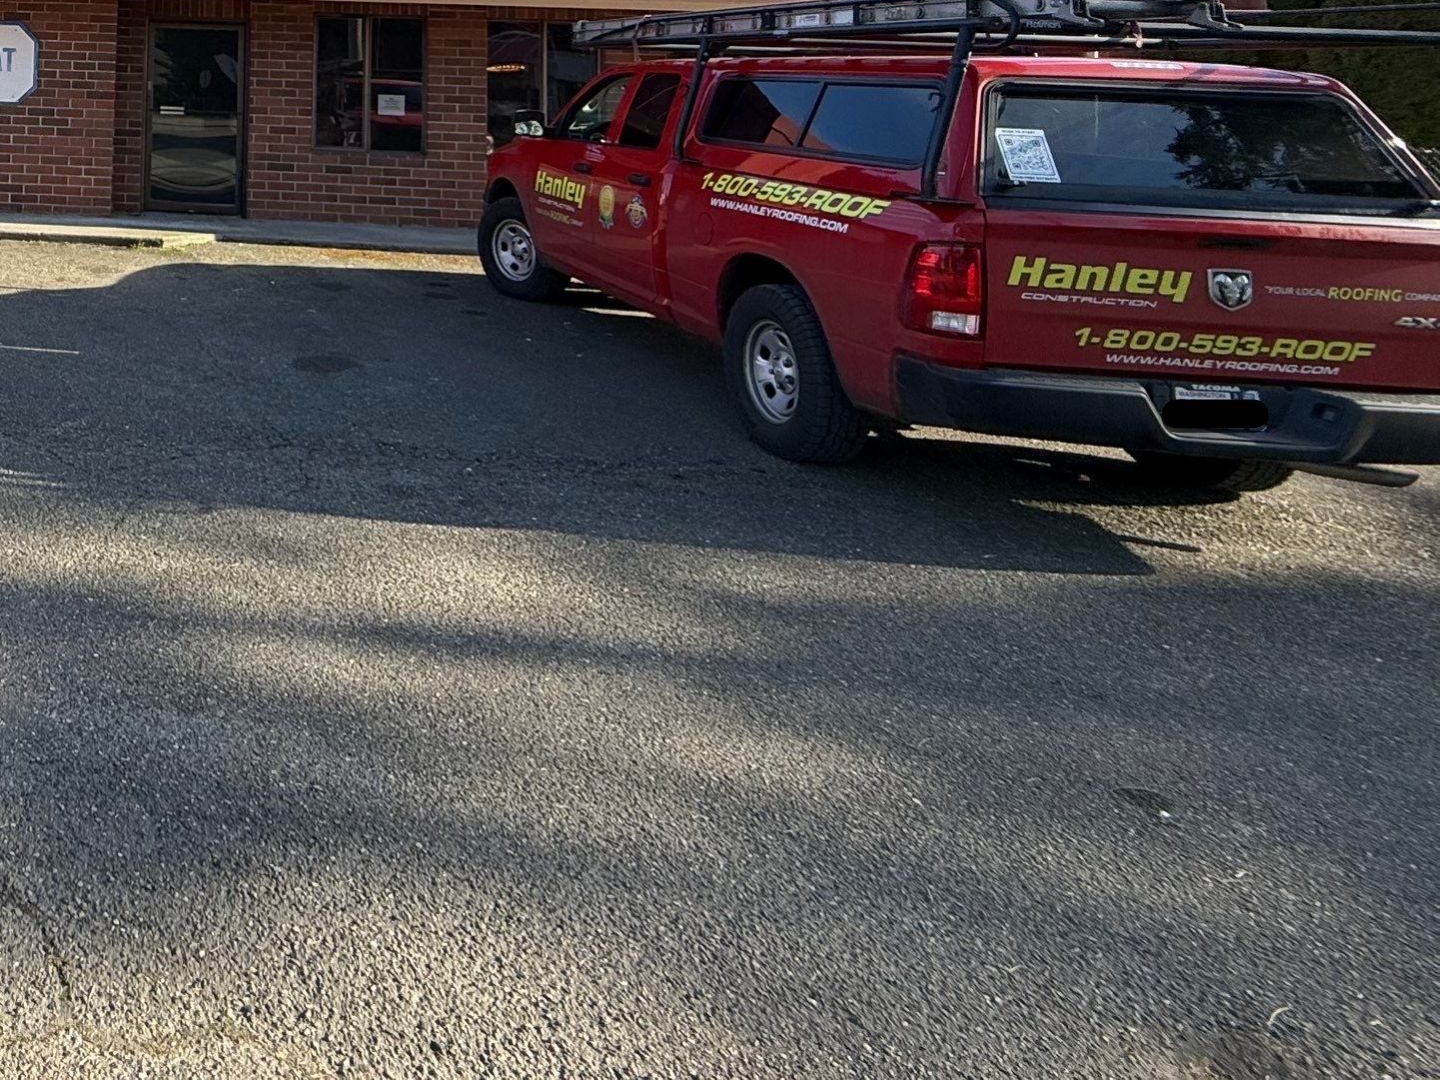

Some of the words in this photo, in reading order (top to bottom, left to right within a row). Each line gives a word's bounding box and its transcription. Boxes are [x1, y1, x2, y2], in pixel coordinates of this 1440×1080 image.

[535, 170, 586, 209] Hanley
[701, 172, 892, 219] 1-800-593-ROOF
[710, 197, 849, 234] WWW.HANLEYROOFING.COM
[1007, 255, 1193, 303] Hanley
[1021, 292, 1158, 309] CONSTRUCTION
[1328, 286, 1403, 303] ROOFING
[1394, 316, 1440, 329] 4X
[1074, 326, 1377, 363] 1-800-593-ROOF
[1105, 353, 1341, 376] WWW.HANLEYROOFING.COM
[1191, 383, 1241, 392] TACOMA
